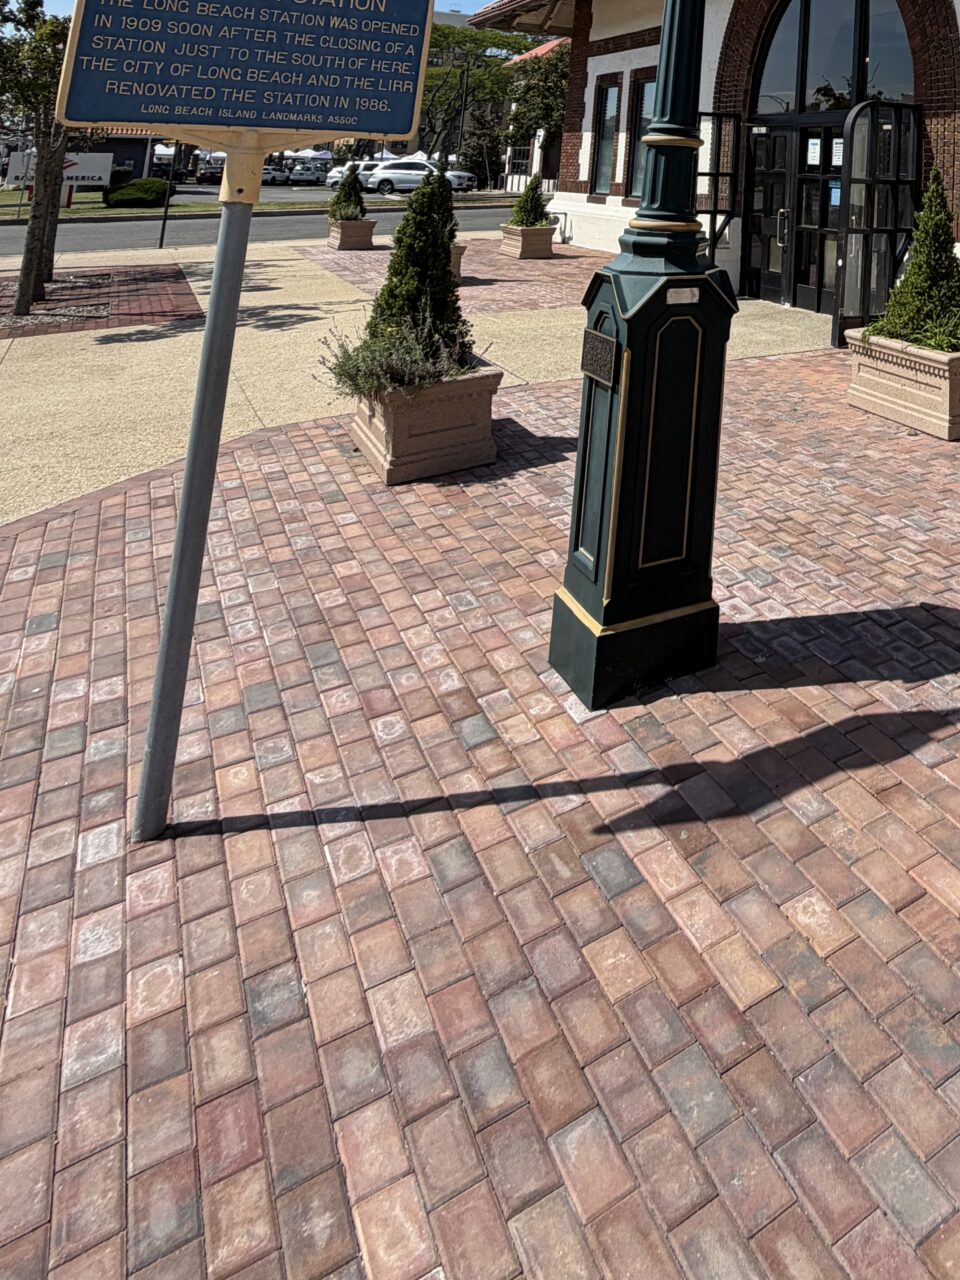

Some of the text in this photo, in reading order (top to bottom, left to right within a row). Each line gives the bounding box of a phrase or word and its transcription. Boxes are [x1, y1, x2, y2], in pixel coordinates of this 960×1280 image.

[94, 14, 415, 56] IN 1909 SOON AFTER THE CLOSING OF A
[196, 2, 256, 20] BEACH
[259, 8, 326, 27] STATION
[329, 16, 358, 31] WAS
[361, 20, 420, 37] OPENED
[91, 35, 415, 75] STATION JUST TO THE SOUTH OF HERE.
[79, 56, 414, 93] THE CITY OF LONG BEACH AND THE LIRR
[105, 80, 391, 112] RENOVATED THE STATION IN 1986.
[140, 104, 358, 125] LONG BEACH ISLAND LANDMARKS ASSOC
